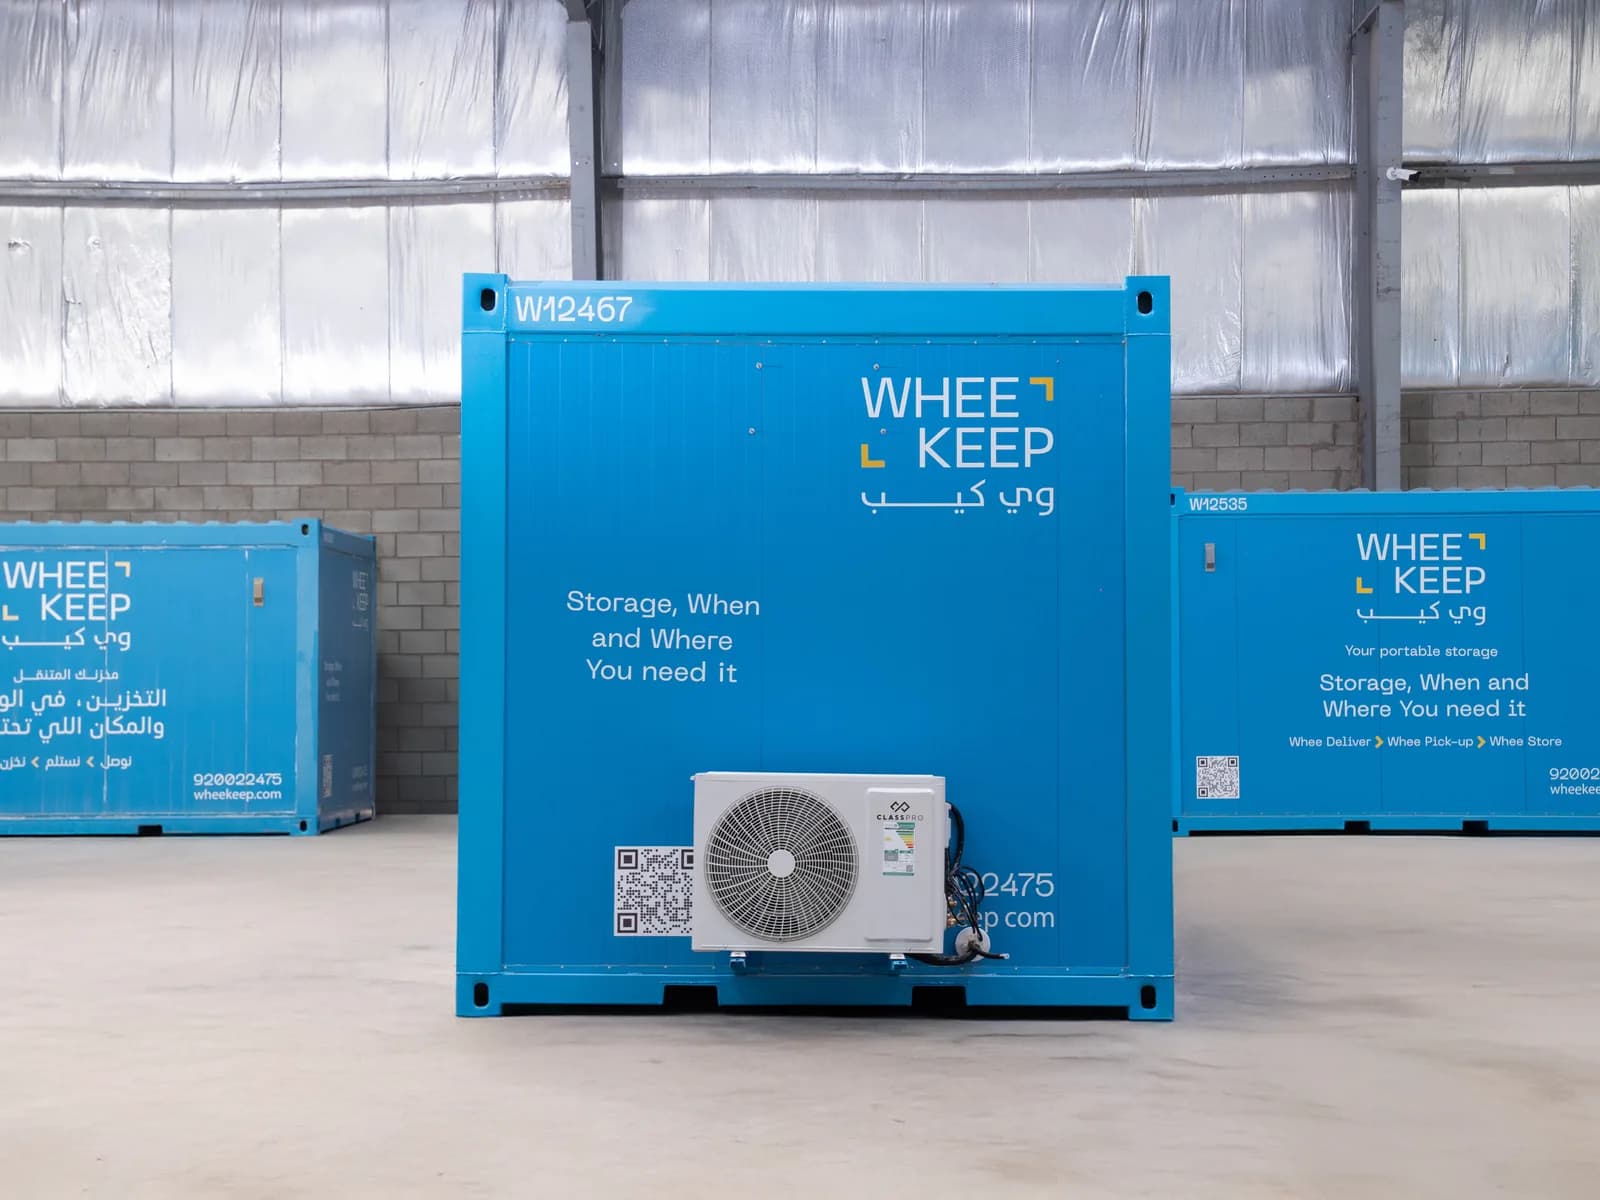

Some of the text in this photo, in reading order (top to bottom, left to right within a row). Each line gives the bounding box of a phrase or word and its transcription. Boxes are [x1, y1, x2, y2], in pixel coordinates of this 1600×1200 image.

[515, 295, 633, 322] W12467
[861, 376, 1019, 418] WHEE
[919, 426, 1054, 468] KEEP
[999, 487, 1054, 516] وي
[1189, 497, 1248, 512] W12535
[1356, 533, 1463, 562] WHEE
[3, 561, 107, 590] WHEE
[1394, 565, 1486, 595] KEEP
[41, 594, 131, 621] KEEP
[566, 590, 760, 618] Storage, When
[1448, 604, 1486, 626] وي
[94, 631, 131, 652] وي
[591, 627, 733, 651] and Where
[1345, 644, 1498, 660] Your portable storage
[586, 658, 738, 683] You need it
[1319, 672, 1530, 696] Storage, When and
[31, 690, 66, 716] في
[1322, 698, 1527, 718] Where You need it
[39, 716, 82, 744] اللي
[89, 715, 165, 740] والمكان
[1289, 735, 1562, 750] Whee Deliver Whee Pick-up Whee Store
[193, 773, 283, 787] 920022475
[193, 788, 282, 802] wheekeep.com
[1004, 911, 1055, 928] com
